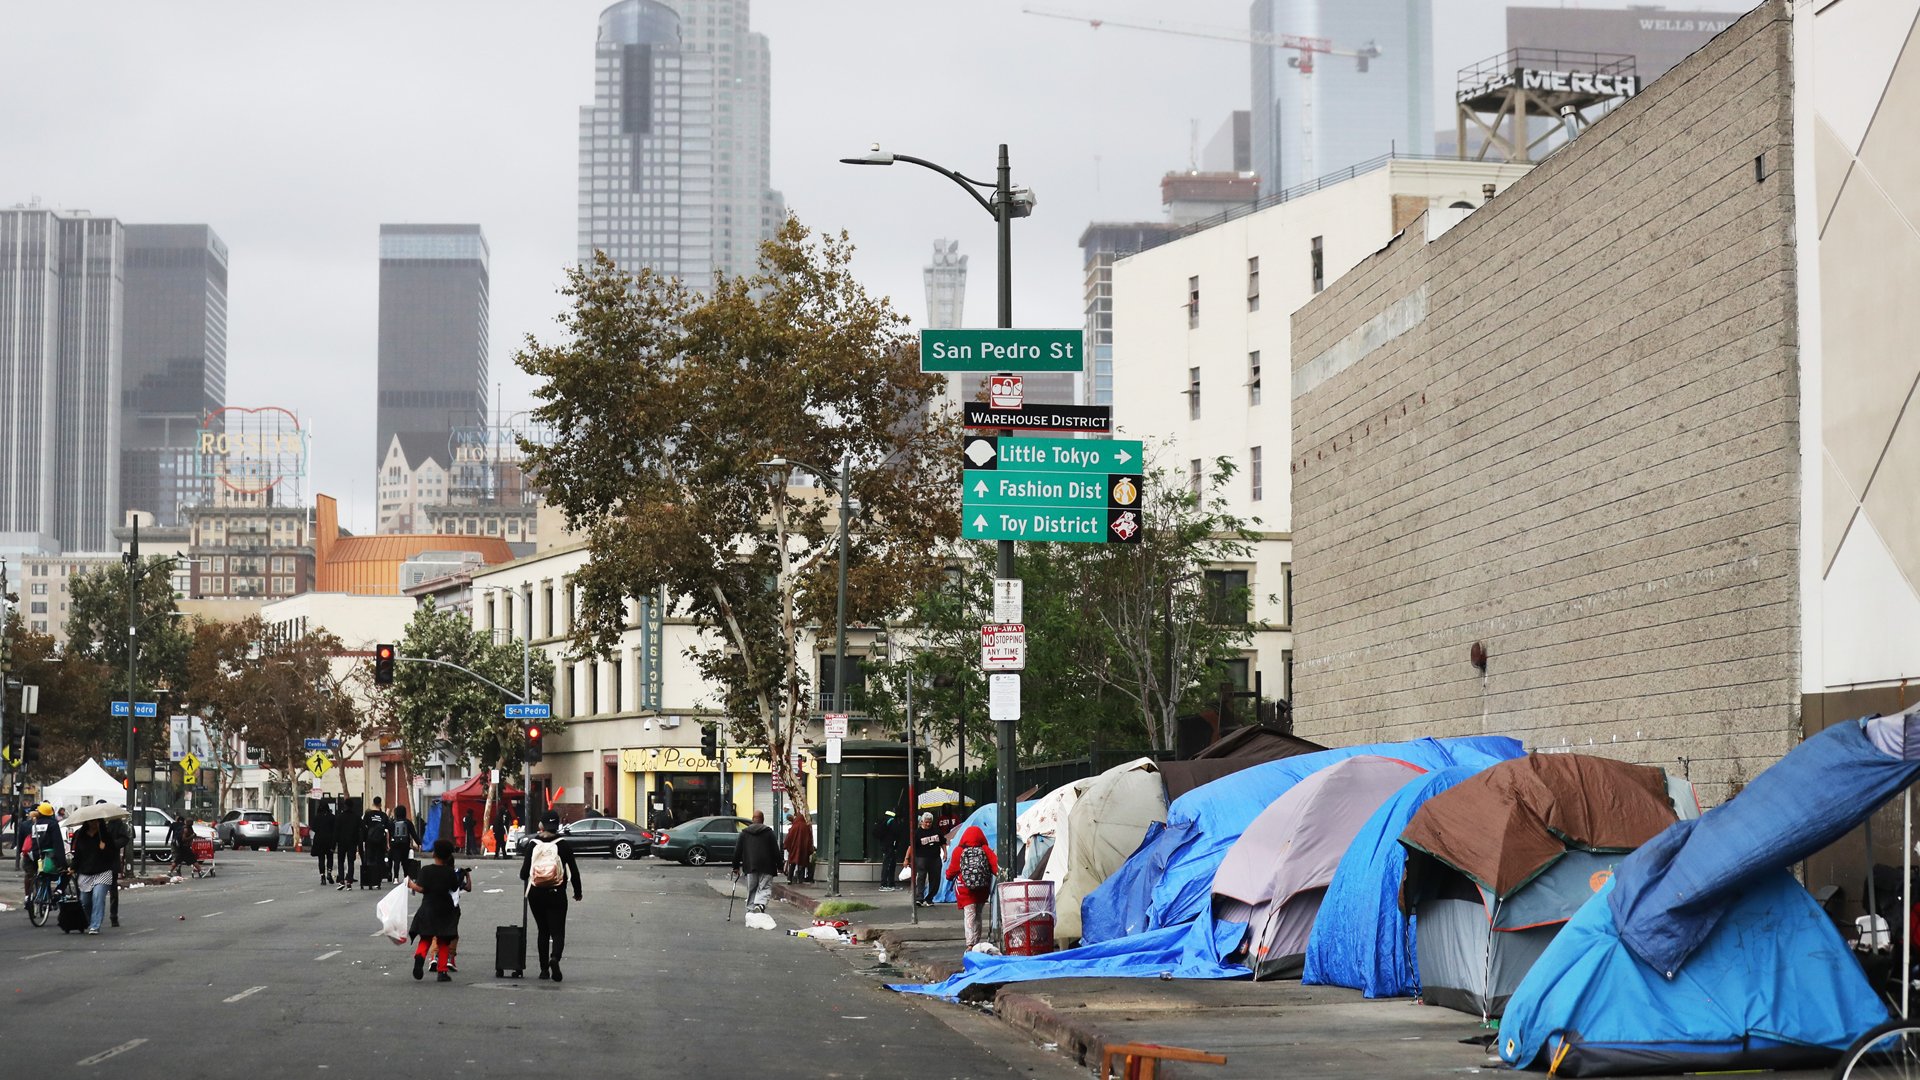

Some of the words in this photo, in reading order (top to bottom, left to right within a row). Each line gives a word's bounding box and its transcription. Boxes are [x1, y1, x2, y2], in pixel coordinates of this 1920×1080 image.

[1640, 20, 1695, 31] WELLS
[1523, 69, 1635, 96] MERCH
[932, 342, 972, 359] San
[981, 342, 1041, 359] Pedro
[1050, 342, 1074, 359] St
[971, 412, 1048, 426] WAREHOUSE
[1051, 414, 1107, 428] DISTRICT
[202, 433, 300, 455] ROSSLYN
[457, 431, 491, 444] NEW
[1000, 445, 1046, 463] Little
[1052, 446, 1100, 468] Tokyo
[999, 479, 1062, 498] Fashion
[1069, 481, 1102, 499] Dist
[1000, 514, 1027, 536] Toy
[1034, 515, 1098, 534] District
[983, 634, 994, 646] NO
[996, 636, 1022, 644] STOPPING
[134, 705, 154, 714] edro
